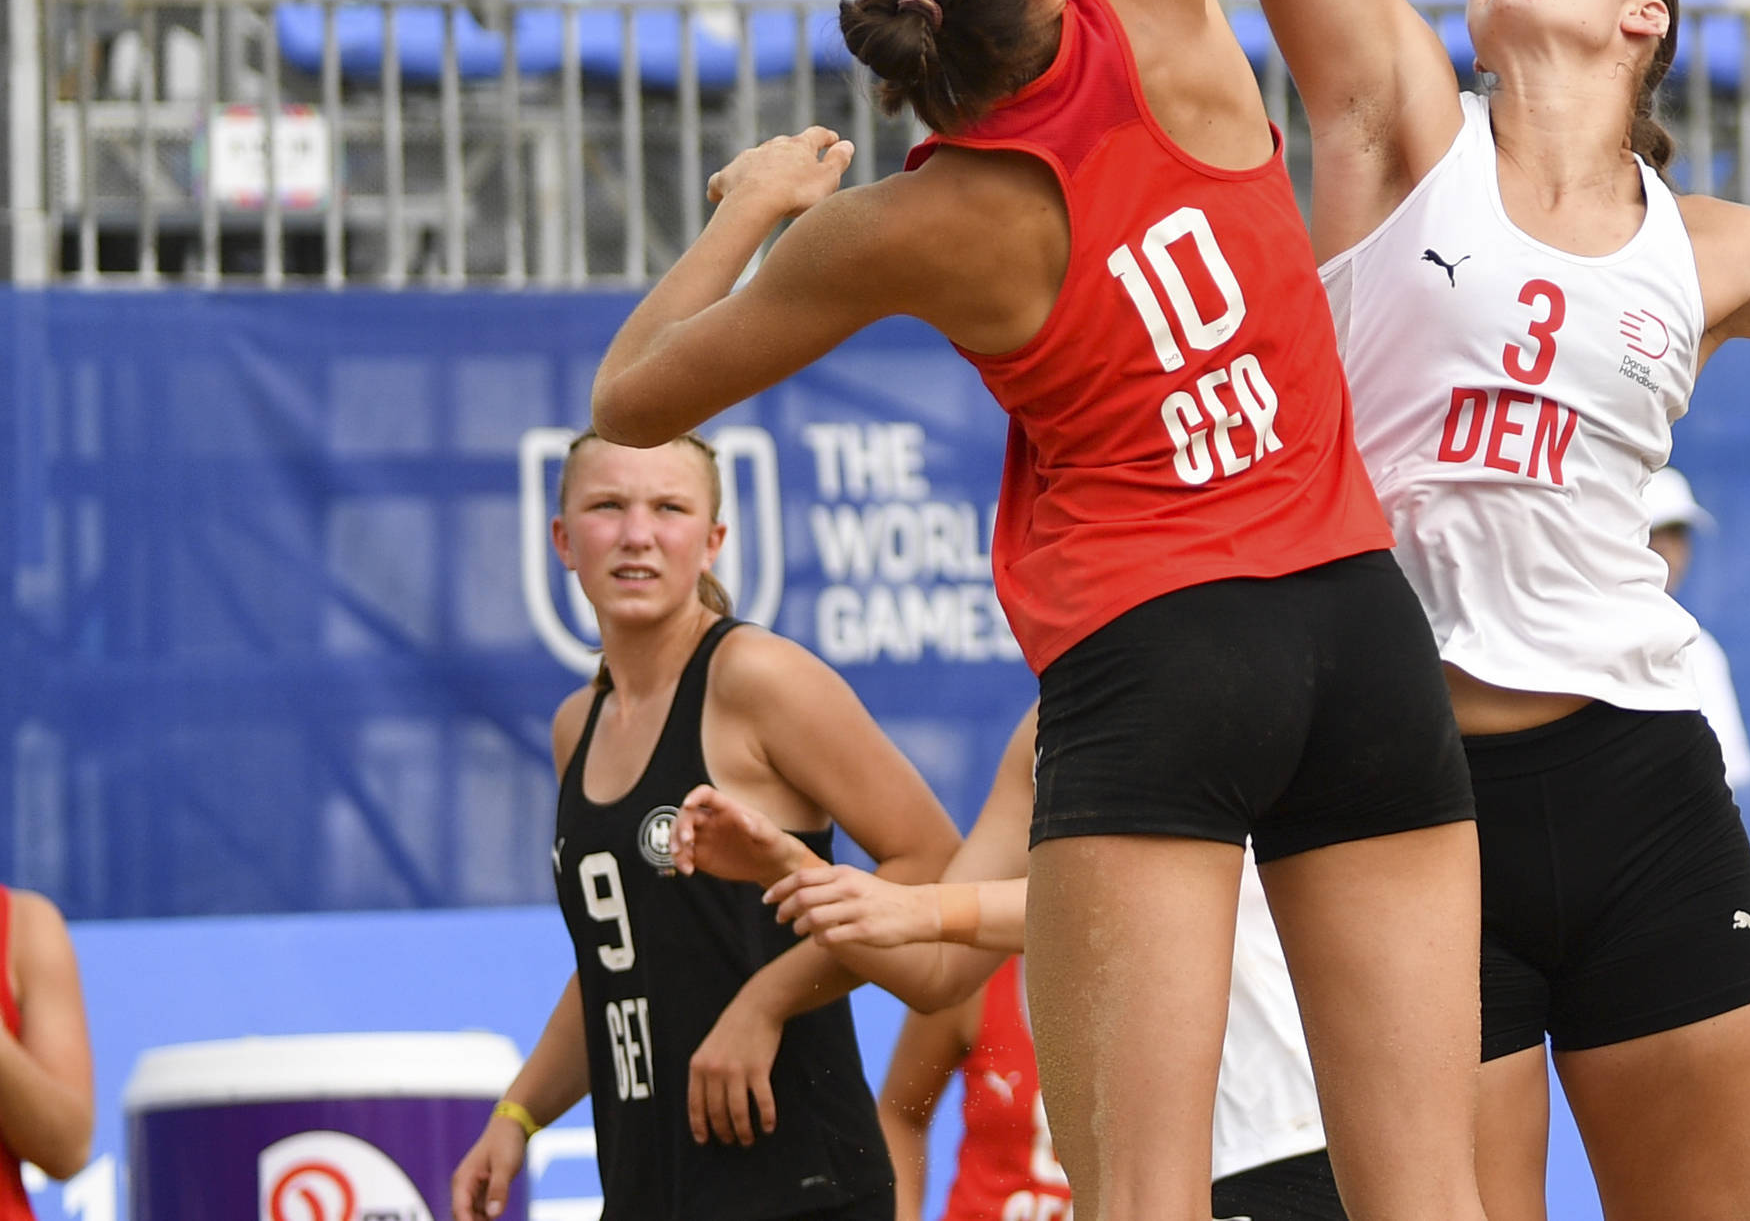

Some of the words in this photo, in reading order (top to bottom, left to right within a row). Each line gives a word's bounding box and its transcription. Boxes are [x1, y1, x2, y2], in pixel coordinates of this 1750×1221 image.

[1107, 207, 1247, 373] 10
[1503, 279, 1566, 385] 3
[1623, 356, 1650, 376] Dansk
[803, 422, 931, 501] THE
[1161, 354, 1283, 485] GER
[1437, 387, 1578, 486] DEN
[811, 503, 1000, 582] WORL
[579, 851, 635, 972] 9
